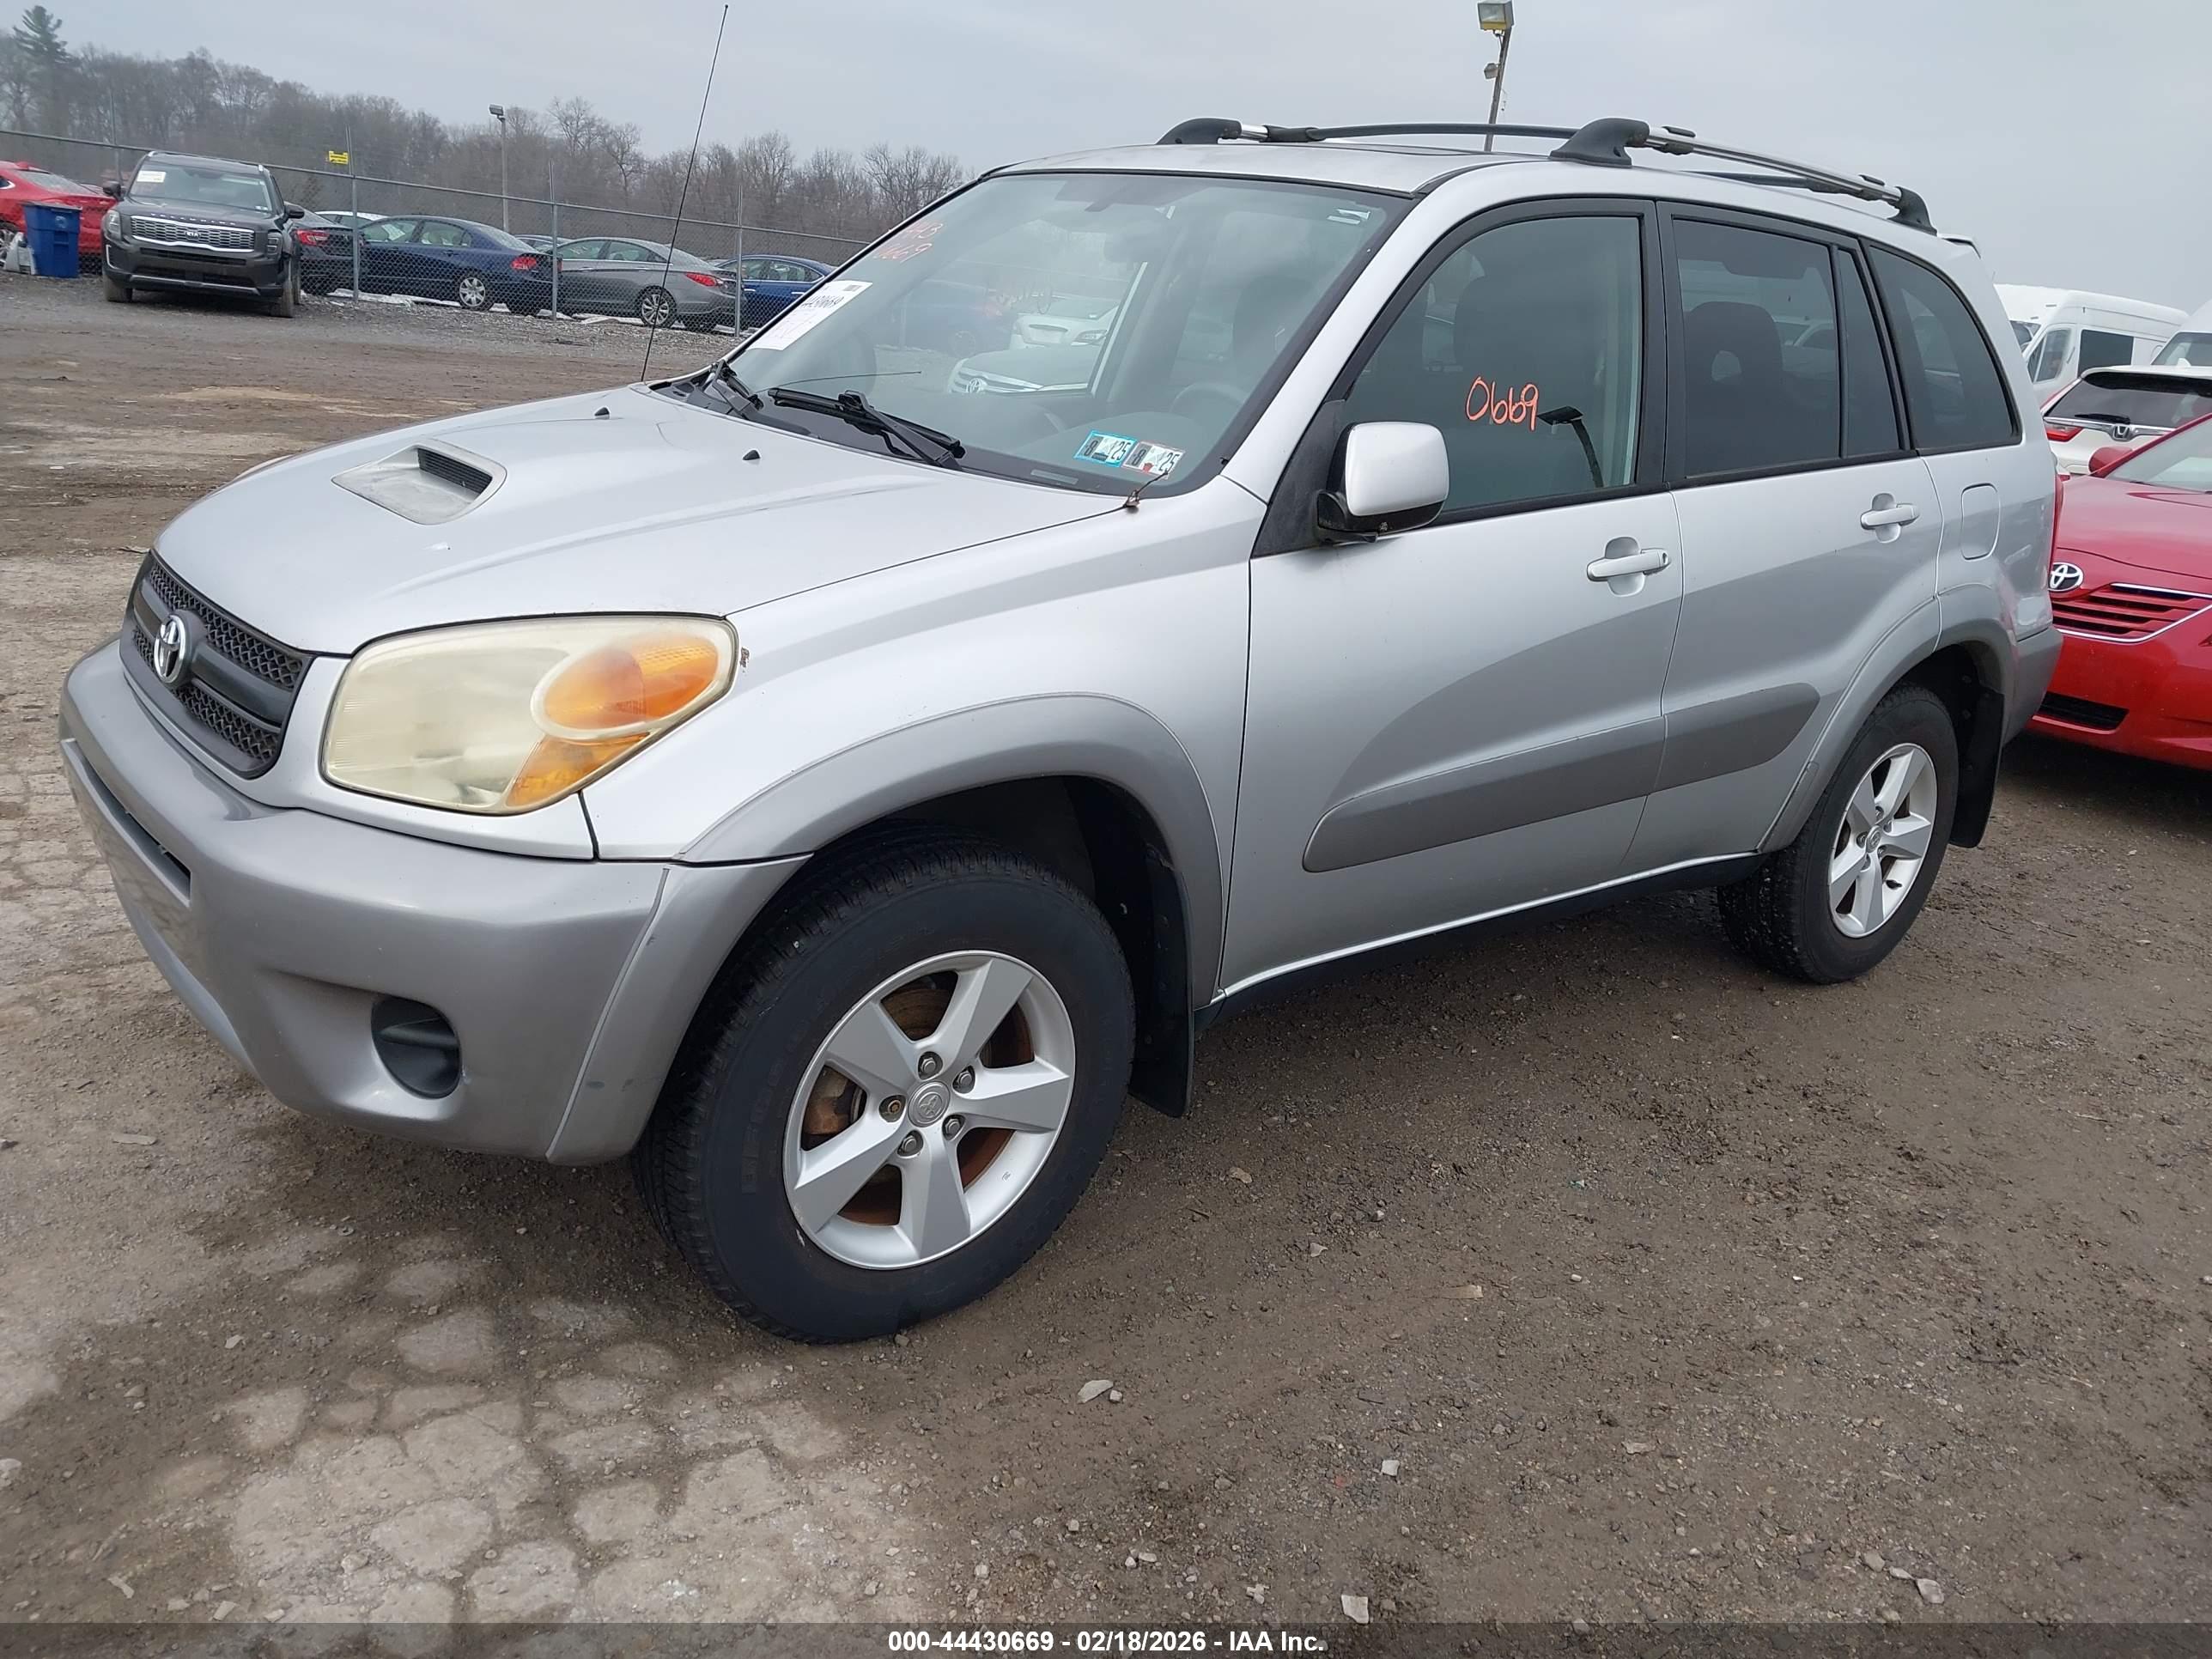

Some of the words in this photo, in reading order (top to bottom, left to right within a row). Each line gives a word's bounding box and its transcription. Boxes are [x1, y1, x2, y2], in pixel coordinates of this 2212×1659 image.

[1467, 376, 1539, 431] 0669
[1084, 440, 1098, 457] 8
[1133, 449, 1147, 466] 8
